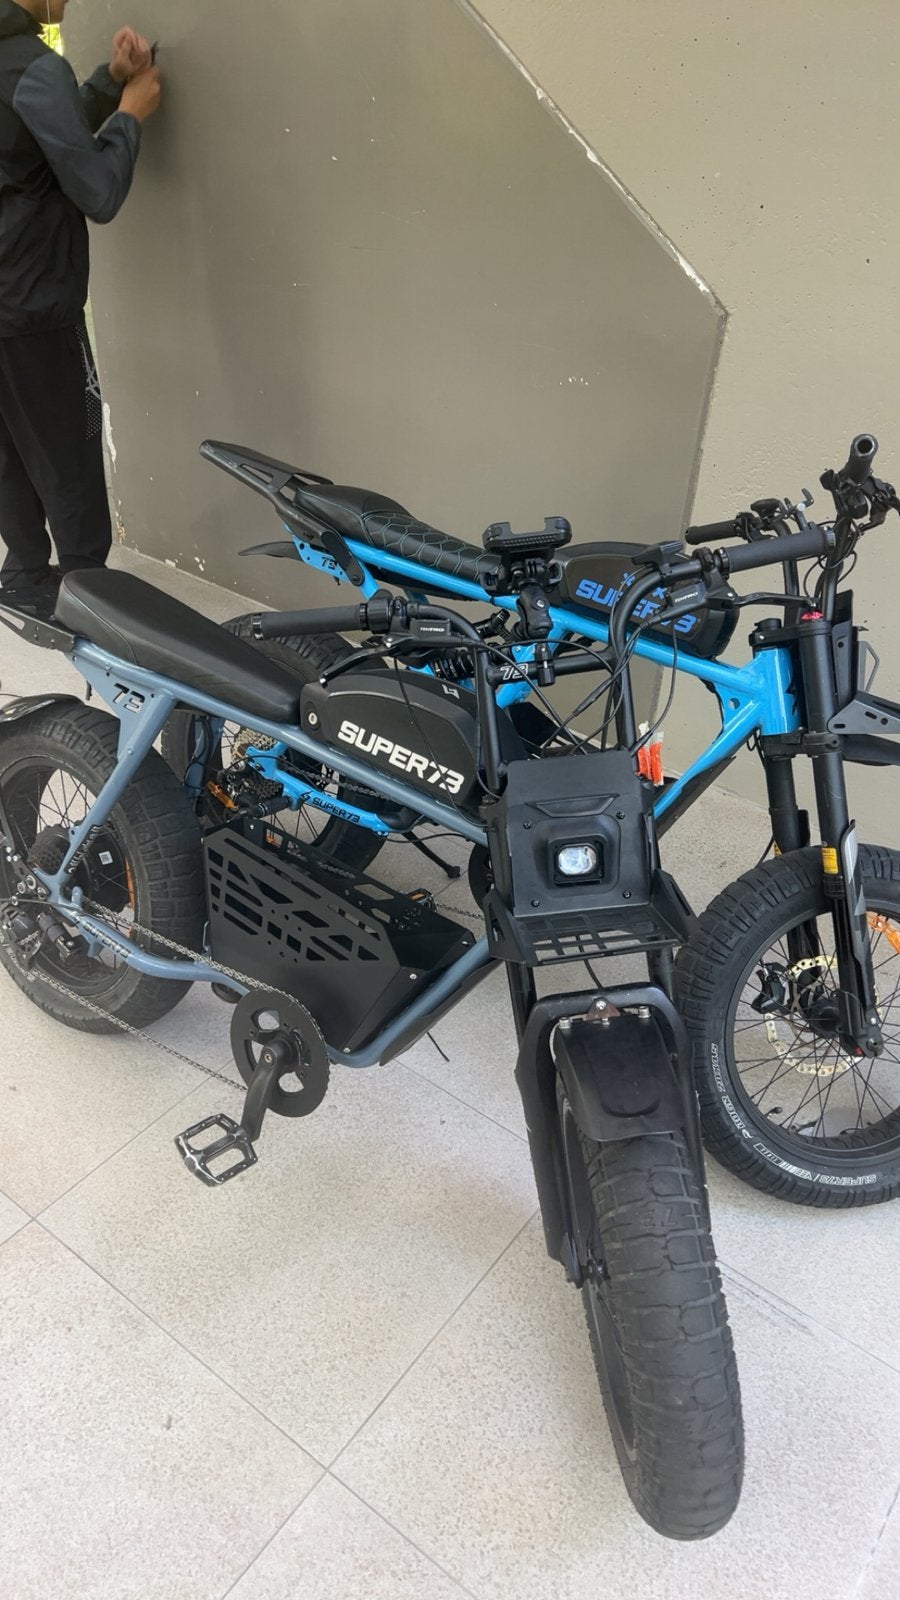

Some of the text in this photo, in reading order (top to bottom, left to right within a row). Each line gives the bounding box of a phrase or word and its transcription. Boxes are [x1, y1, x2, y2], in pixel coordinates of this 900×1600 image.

[500, 663, 529, 681] 73
[112, 682, 146, 714] 73
[337, 720, 465, 794] SUPER73
[312, 796, 361, 823] SUPER73
